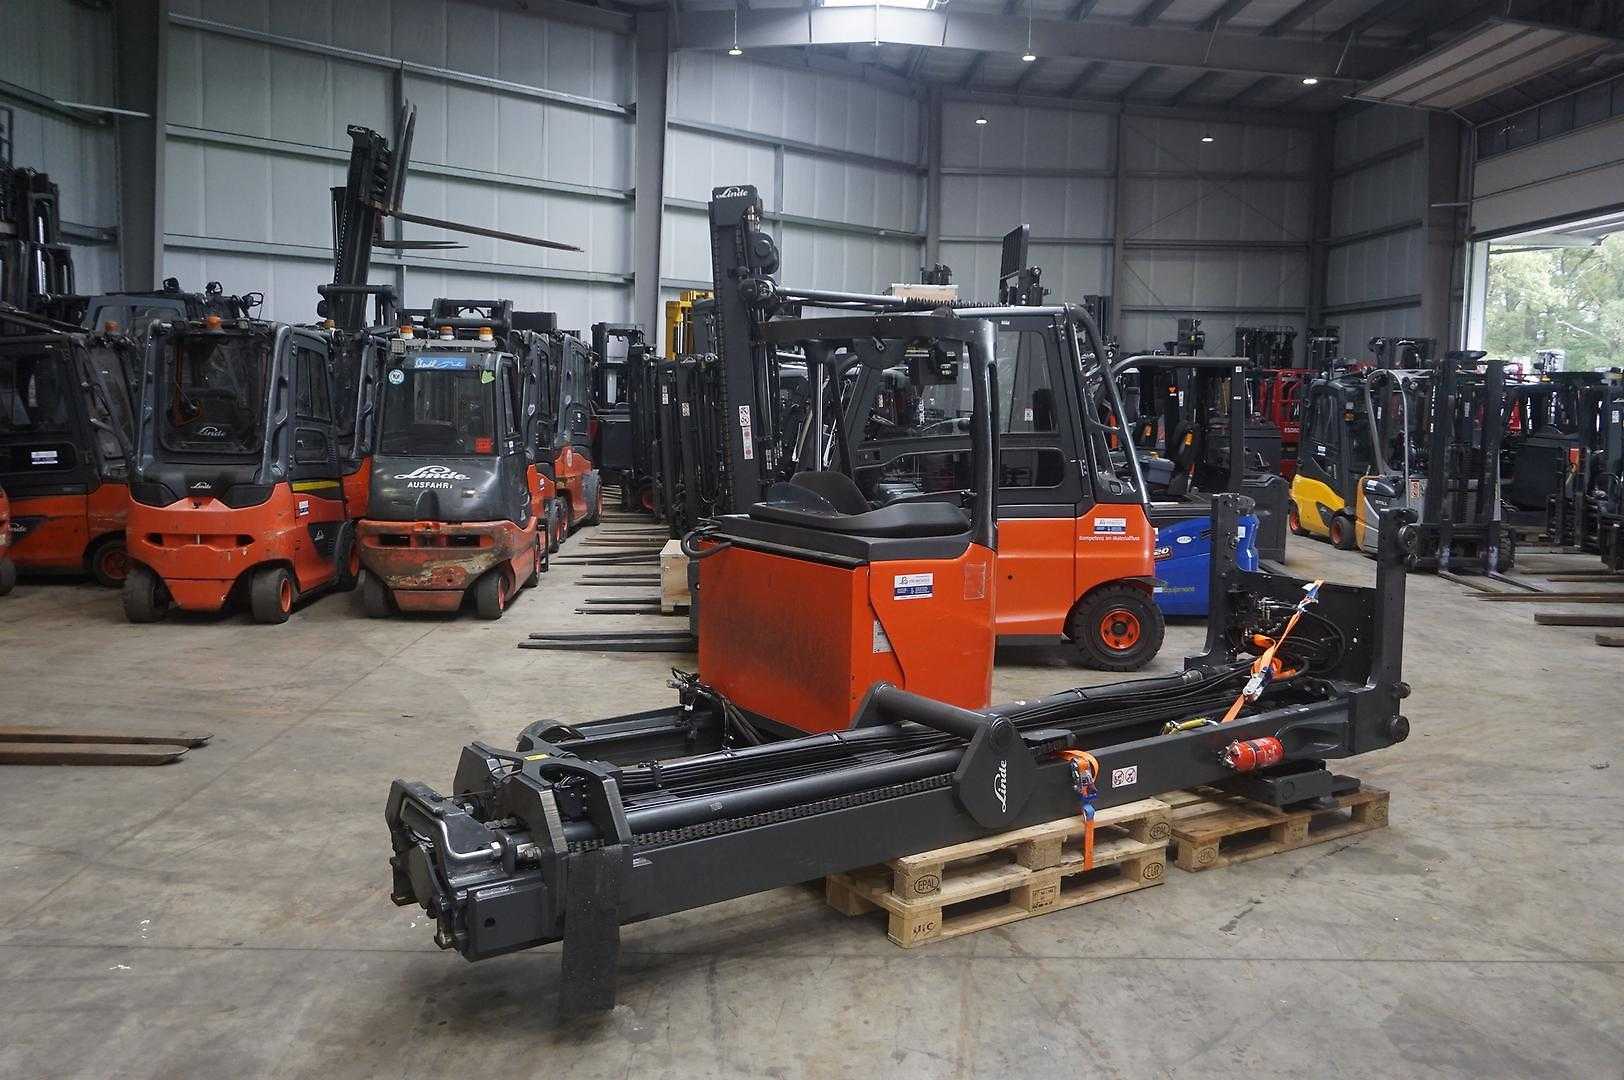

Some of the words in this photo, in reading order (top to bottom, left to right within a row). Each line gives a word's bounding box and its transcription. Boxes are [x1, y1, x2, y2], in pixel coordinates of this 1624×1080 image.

[714, 186, 749, 198] Linde
[394, 465, 471, 480] Linde
[994, 760, 1007, 812] Linde
[917, 878, 938, 891] EPAL
